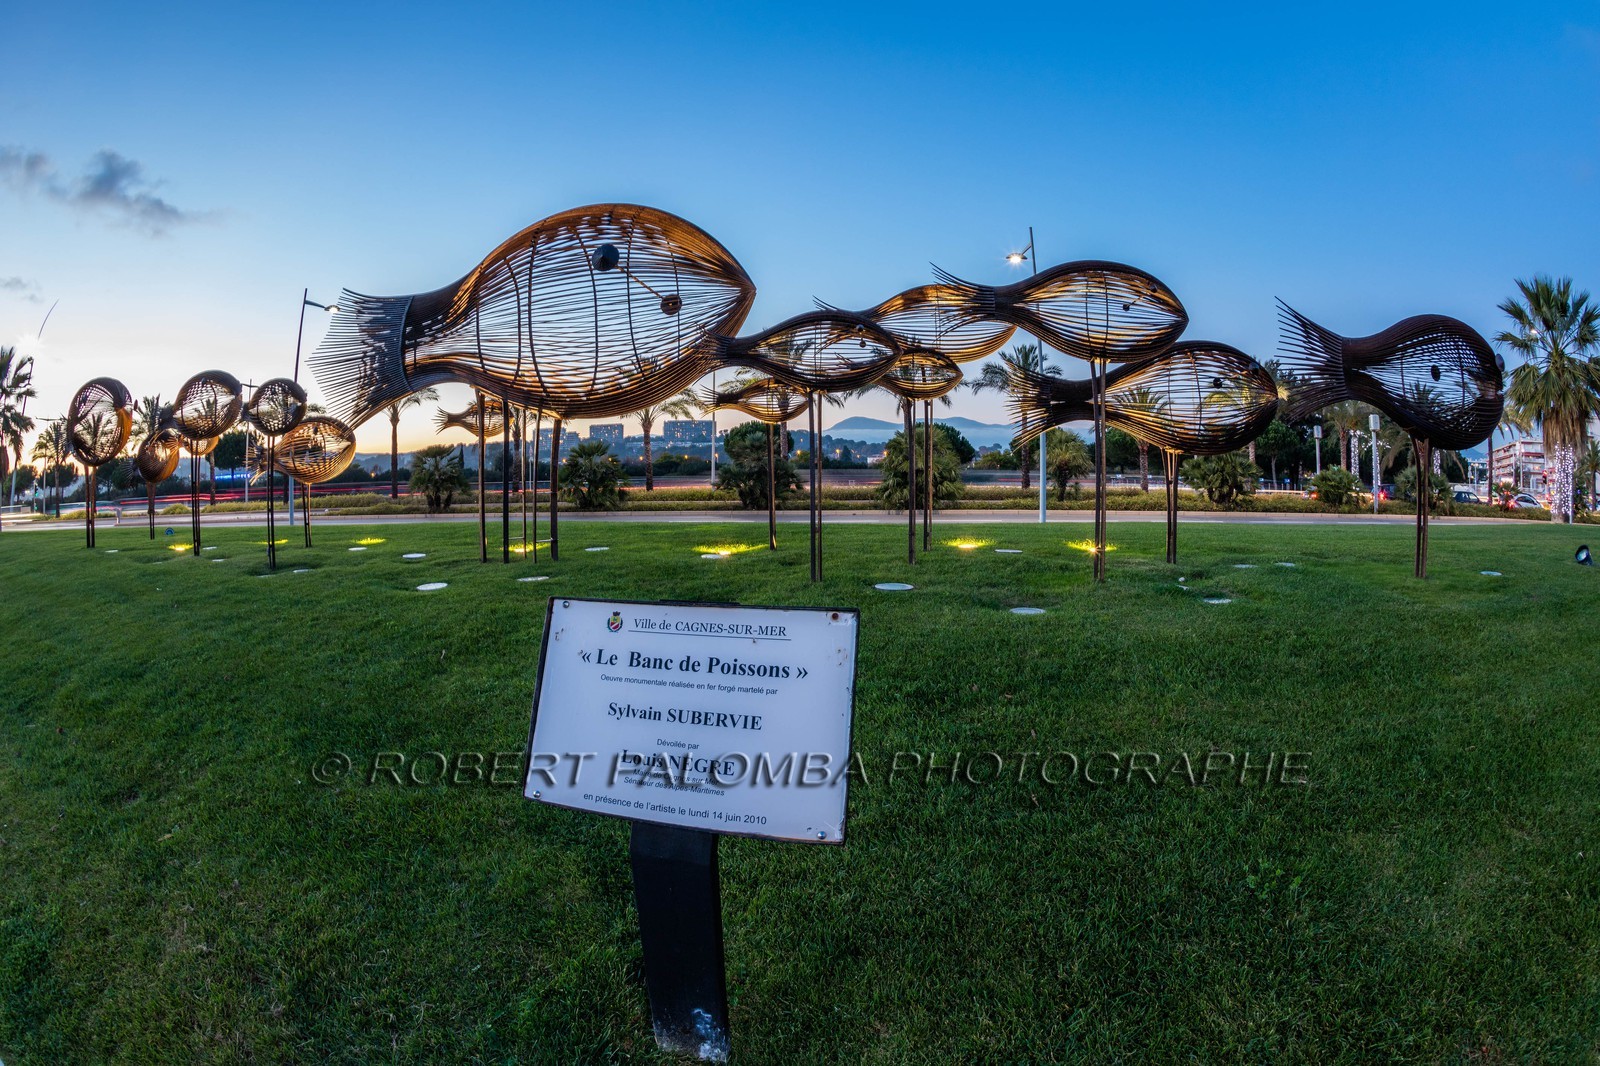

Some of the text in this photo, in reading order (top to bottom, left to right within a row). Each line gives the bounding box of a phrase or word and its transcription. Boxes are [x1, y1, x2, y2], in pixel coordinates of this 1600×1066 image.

[634, 618, 787, 637] Ville de CAGNES-SUR-MER
[596, 648, 618, 666] Le
[628, 651, 674, 671] Banc
[679, 655, 701, 673] de
[706, 657, 790, 679] Poissons
[600, 674, 623, 683] Oeuvre
[624, 677, 668, 687] monumentale
[668, 680, 695, 690] réalisée
[706, 683, 716, 691] fer
[717, 684, 736, 694] forgé
[737, 686, 765, 695] martelé
[765, 688, 778, 696] par
[607, 702, 763, 731] Sylvain SUBERVIE
[656, 738, 700, 750] Dévoilée par
[621, 749, 663, 768] Louis
[654, 781, 667, 789] des
[668, 783, 725, 796] Alpes-Maritimes
[583, 791, 594, 800] en
[595, 794, 631, 807] présence
[633, 800, 644, 809] de
[678, 806, 686, 815] le
[688, 807, 710, 818] lundi
[712, 811, 723, 820] 14
[724, 812, 742, 823] juin
[743, 814, 767, 825] 2010
